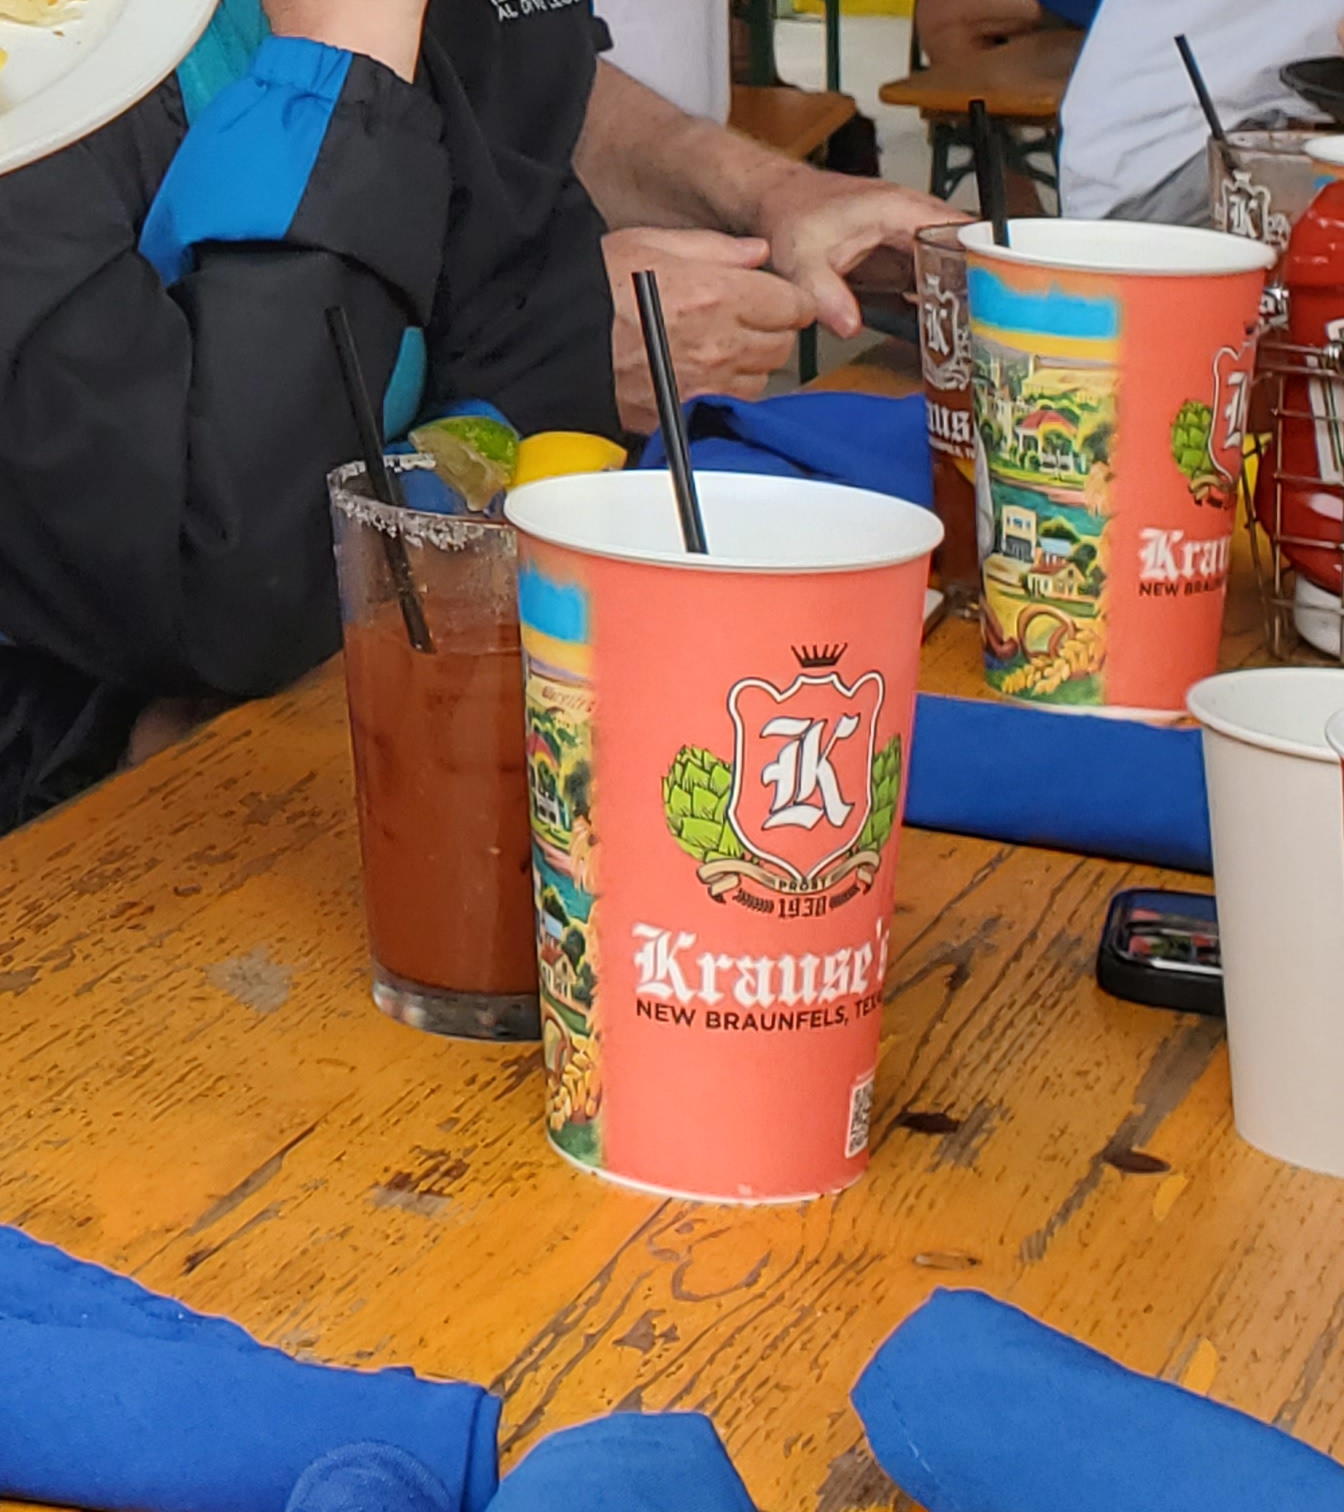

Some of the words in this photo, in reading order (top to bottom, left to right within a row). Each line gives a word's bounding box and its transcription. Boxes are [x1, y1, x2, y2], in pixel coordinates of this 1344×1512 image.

[1138, 582, 1180, 597] NEW
[760, 712, 861, 831] K
[636, 999, 695, 1028] NEW
[705, 1004, 849, 1031] BRAUNFELS,
